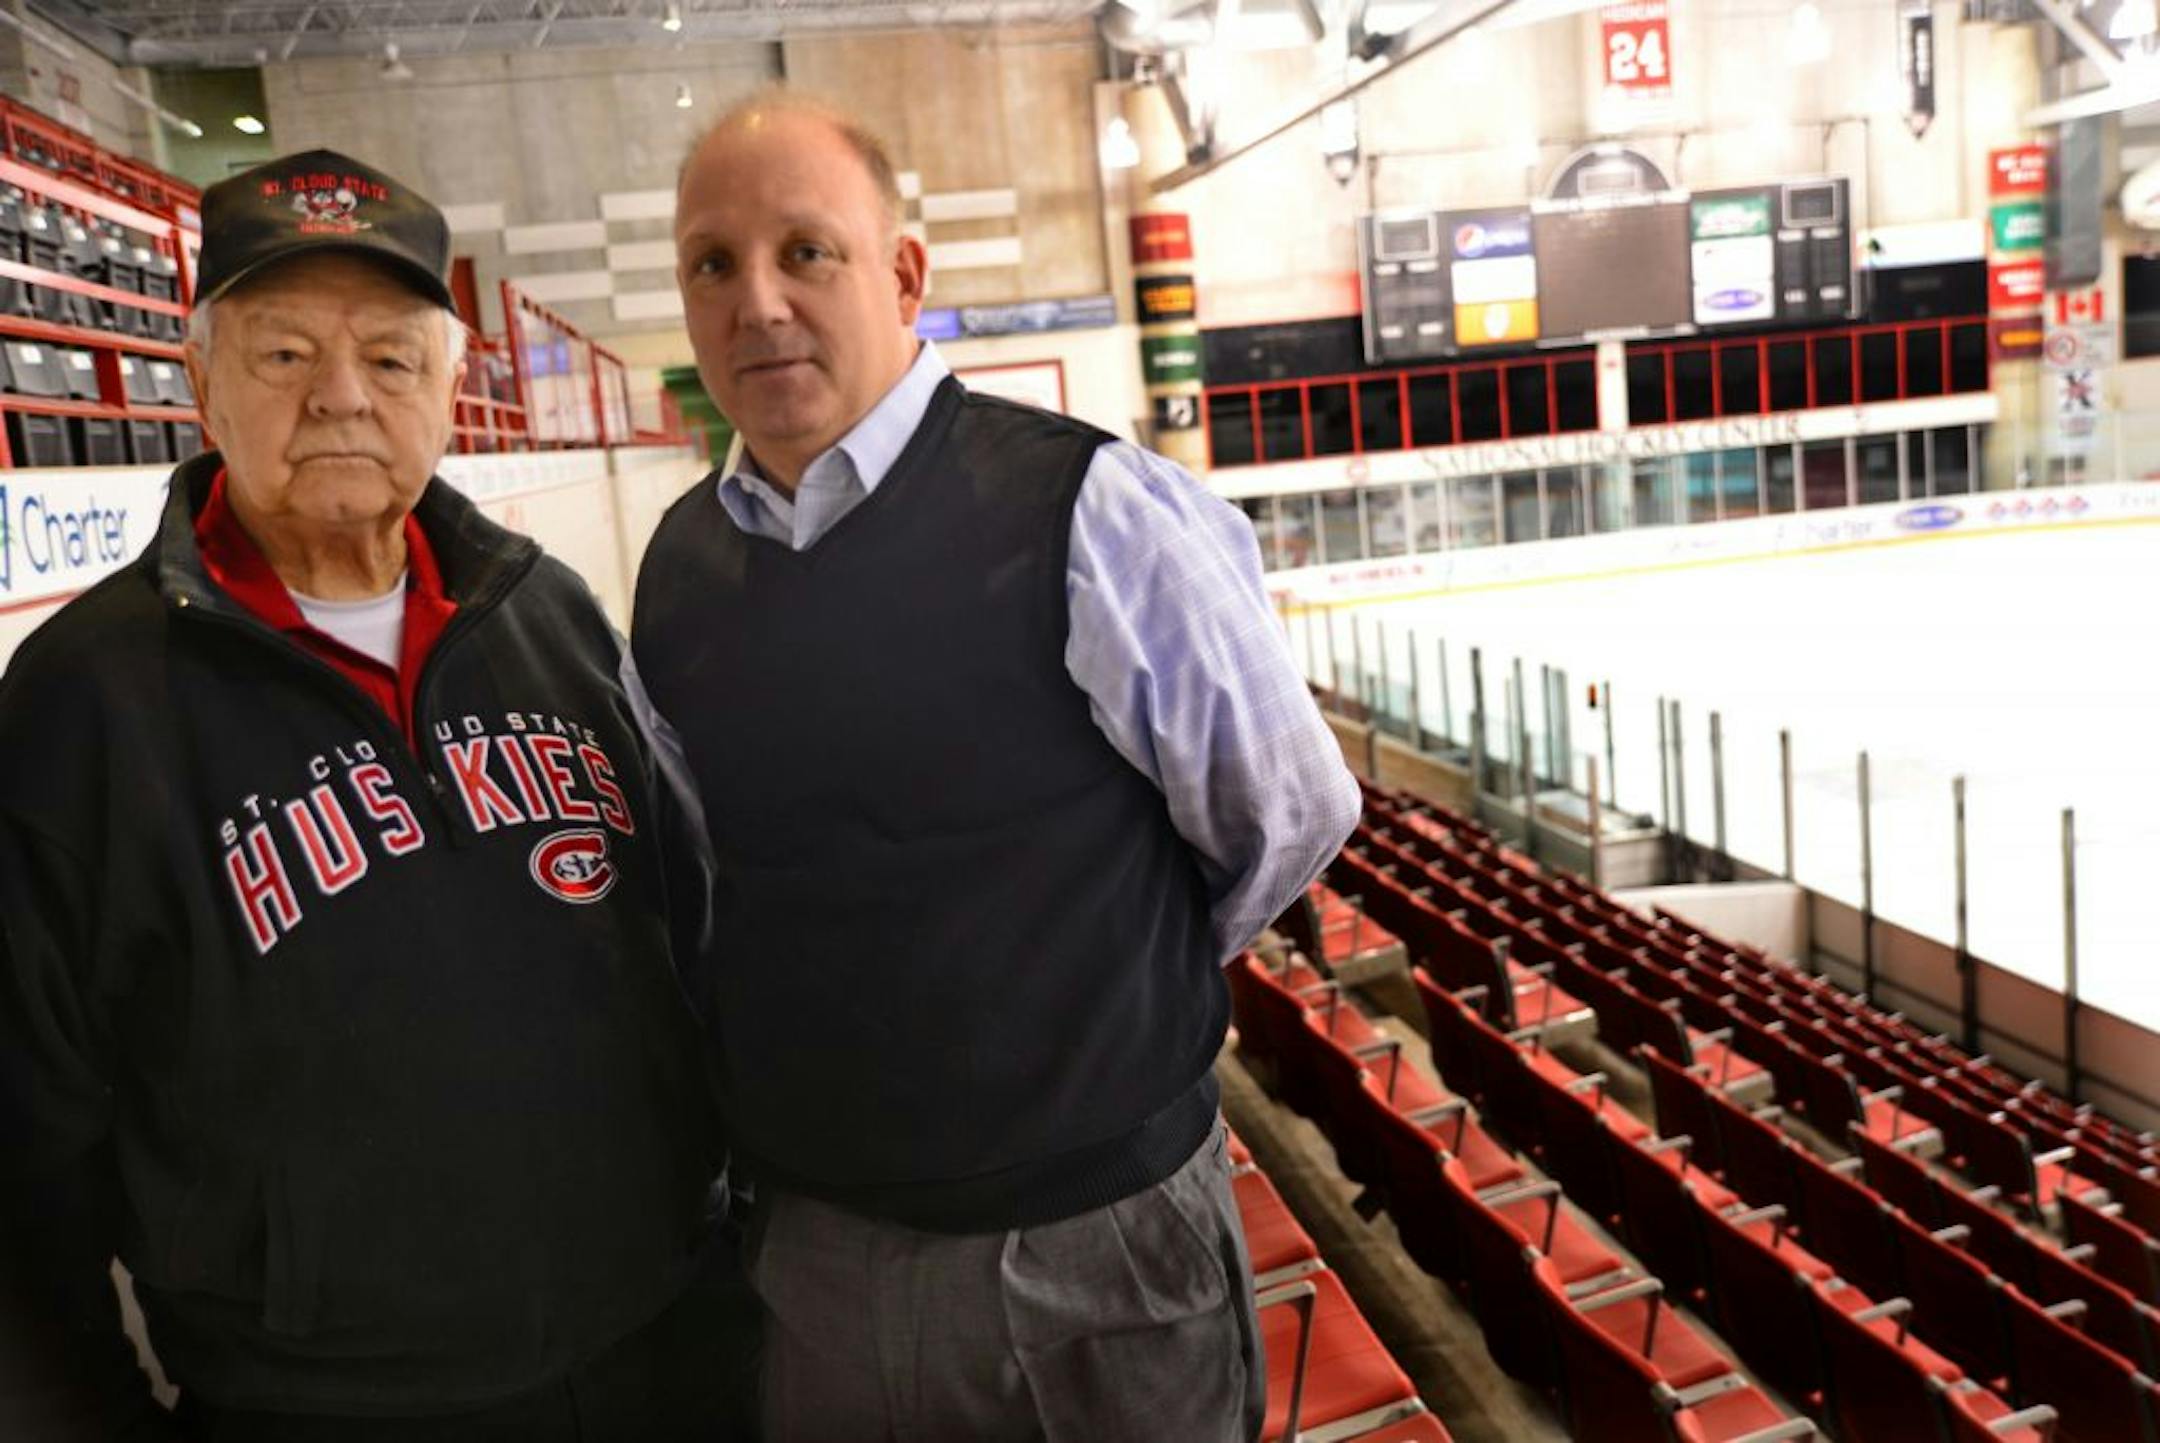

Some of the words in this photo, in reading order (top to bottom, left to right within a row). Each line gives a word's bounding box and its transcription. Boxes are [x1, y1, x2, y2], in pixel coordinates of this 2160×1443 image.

[1609, 29, 1665, 80] 24
[290, 174, 338, 190] CLOUD
[344, 175, 390, 201] STATE
[1697, 414, 1801, 447] CENTER
[22, 493, 128, 574] Charter
[219, 794, 278, 846] ST.
[508, 711, 598, 745] STATE
